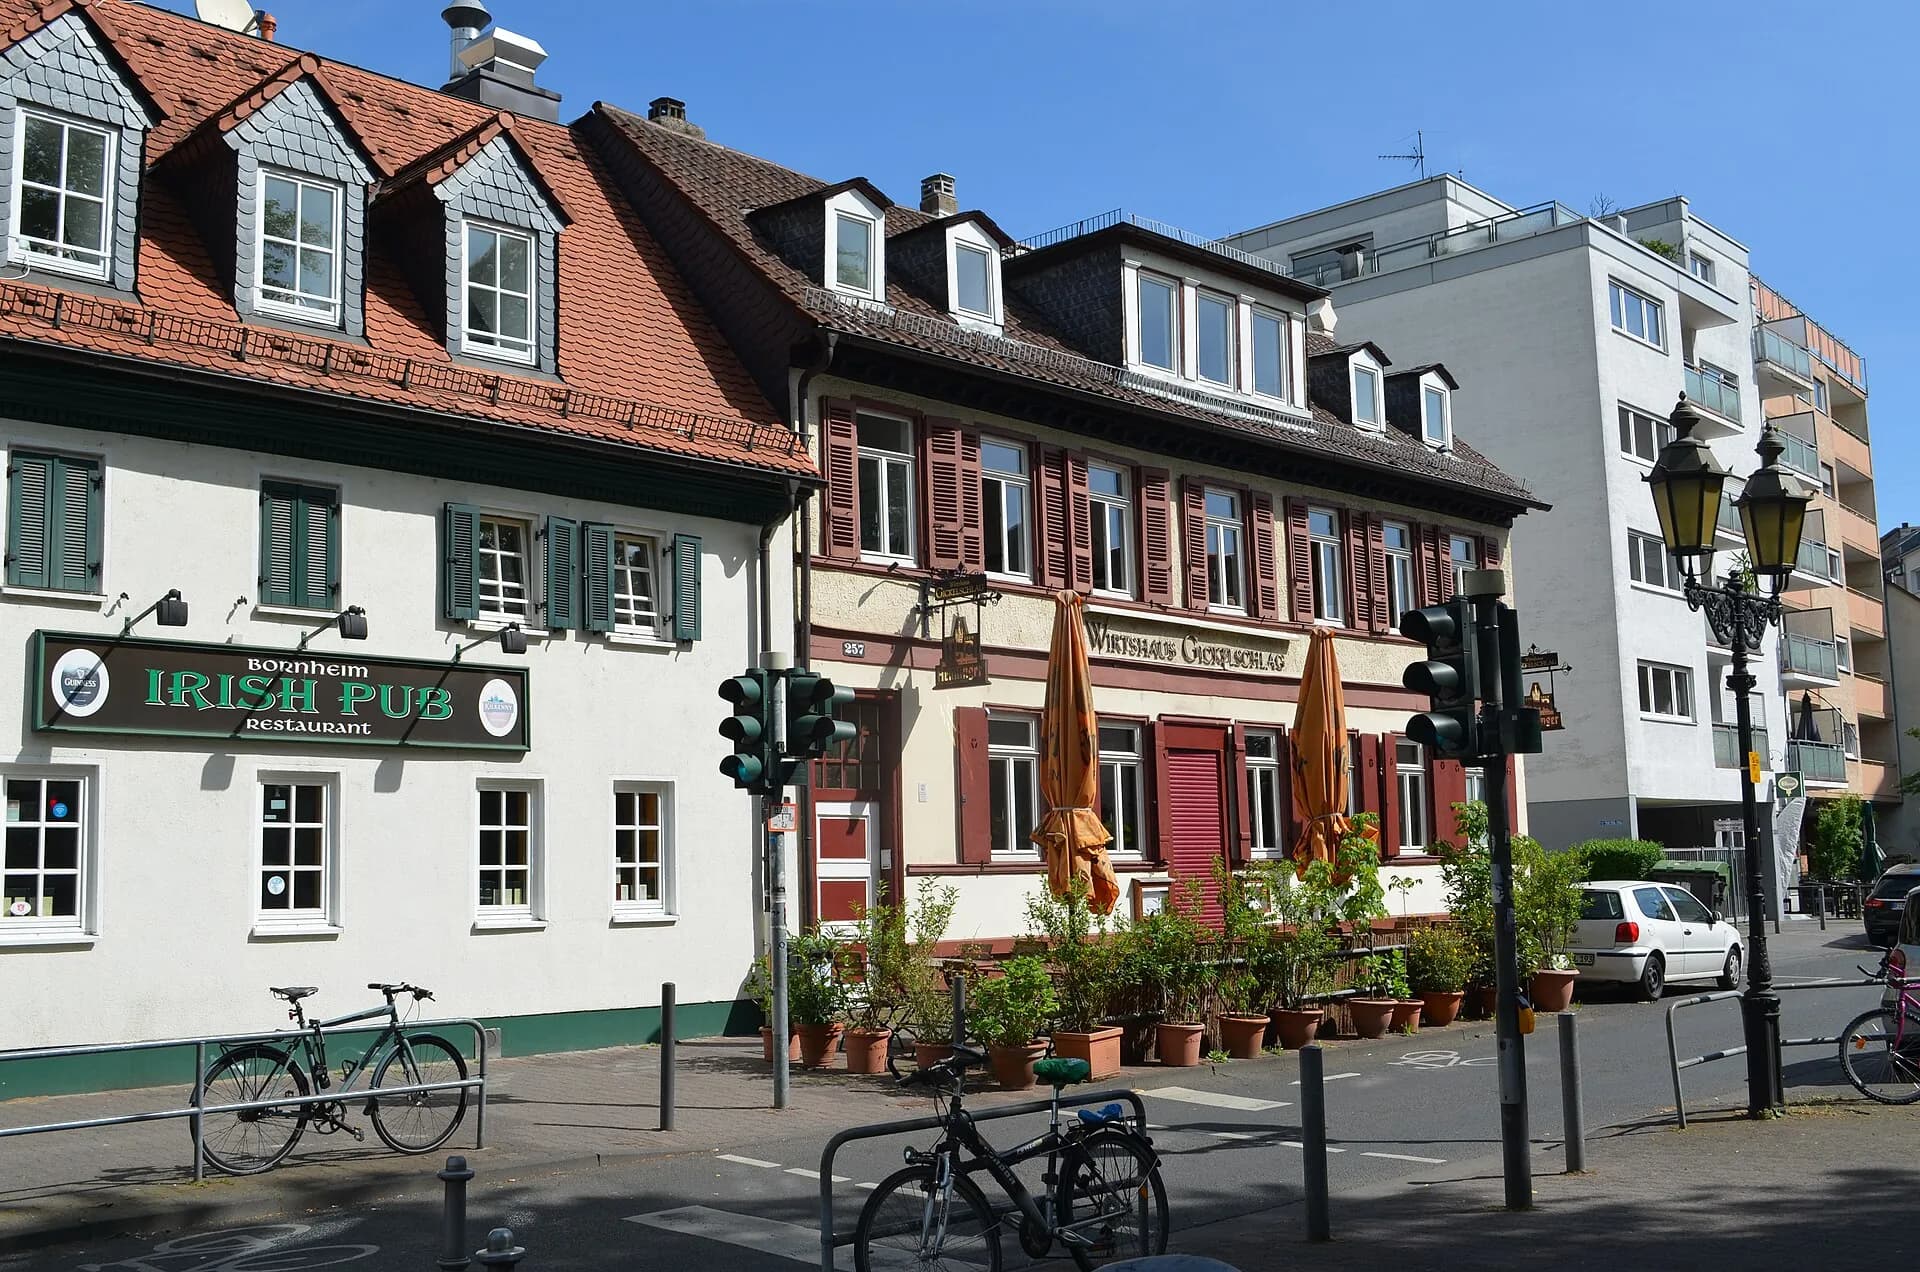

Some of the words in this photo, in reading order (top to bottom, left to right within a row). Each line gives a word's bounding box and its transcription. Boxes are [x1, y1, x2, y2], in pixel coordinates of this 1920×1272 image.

[844, 642, 865, 655] 257
[145, 667, 320, 712] IRISH
[338, 681, 454, 721] PUB
